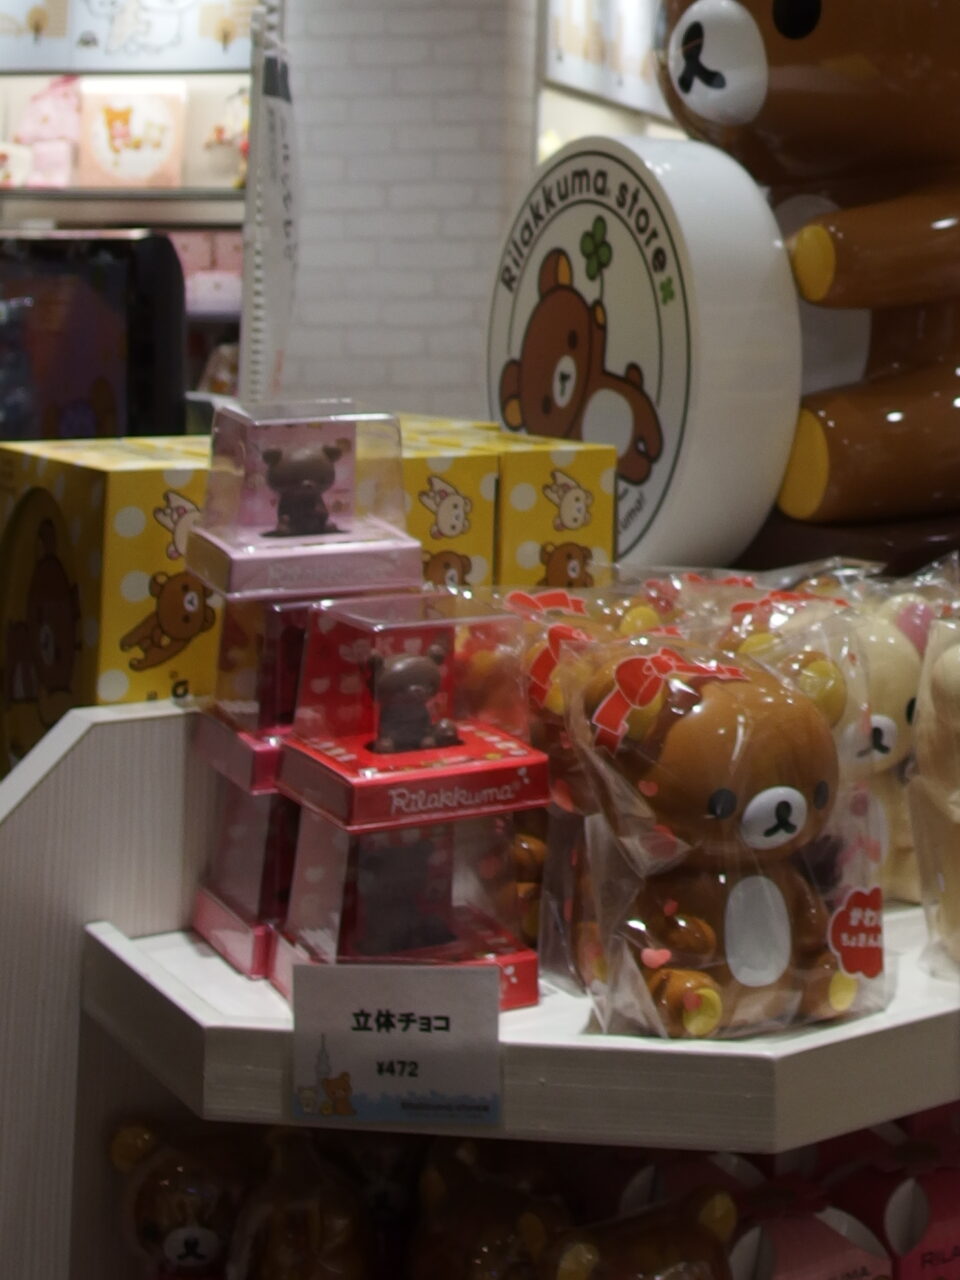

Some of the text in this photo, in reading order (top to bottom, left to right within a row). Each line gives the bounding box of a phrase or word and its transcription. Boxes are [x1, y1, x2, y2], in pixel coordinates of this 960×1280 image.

[500, 168, 668, 293] Rilakkuma store
[388, 783, 516, 816] Rilakkuma
[351, 1009, 451, 1033] 立体チョコ
[376, 1060, 419, 1078] ¥472
